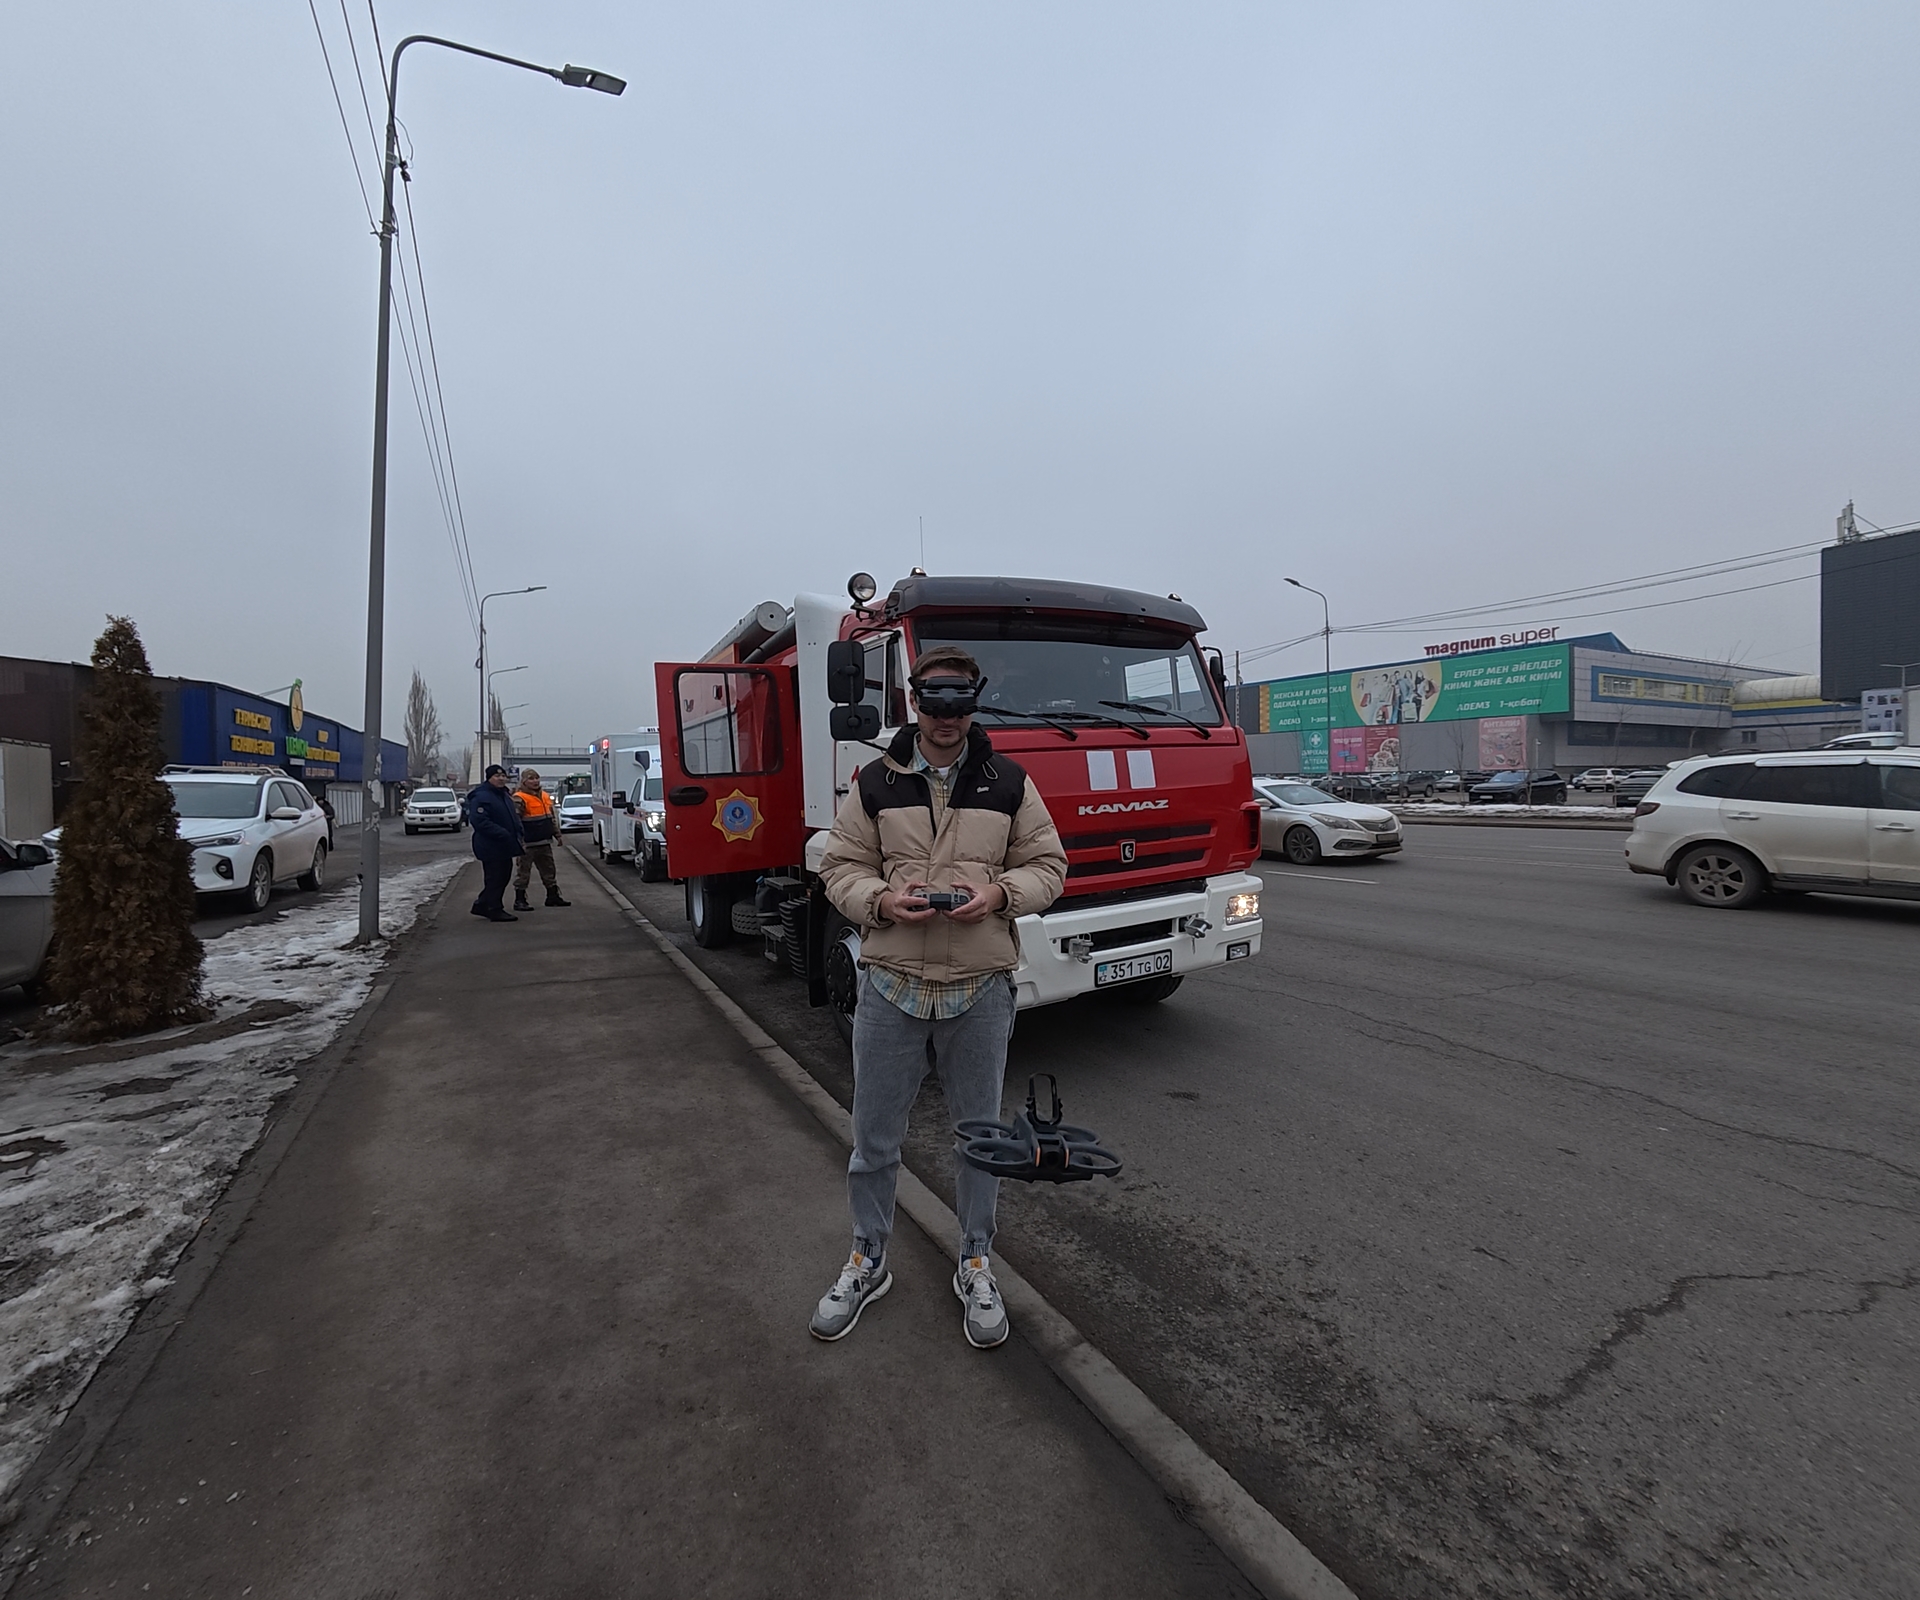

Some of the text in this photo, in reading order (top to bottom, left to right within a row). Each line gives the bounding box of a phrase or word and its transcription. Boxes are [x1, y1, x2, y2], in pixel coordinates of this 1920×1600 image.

[1423, 626, 1560, 655] magnum super
[1454, 668, 1484, 679] ЕРЛЕР
[1486, 665, 1509, 675] МЕН
[1273, 690, 1304, 699] ЖЕНСКАЯ
[1078, 799, 1169, 815] KAMAZ
[1111, 954, 1170, 979] 351 TG 02
